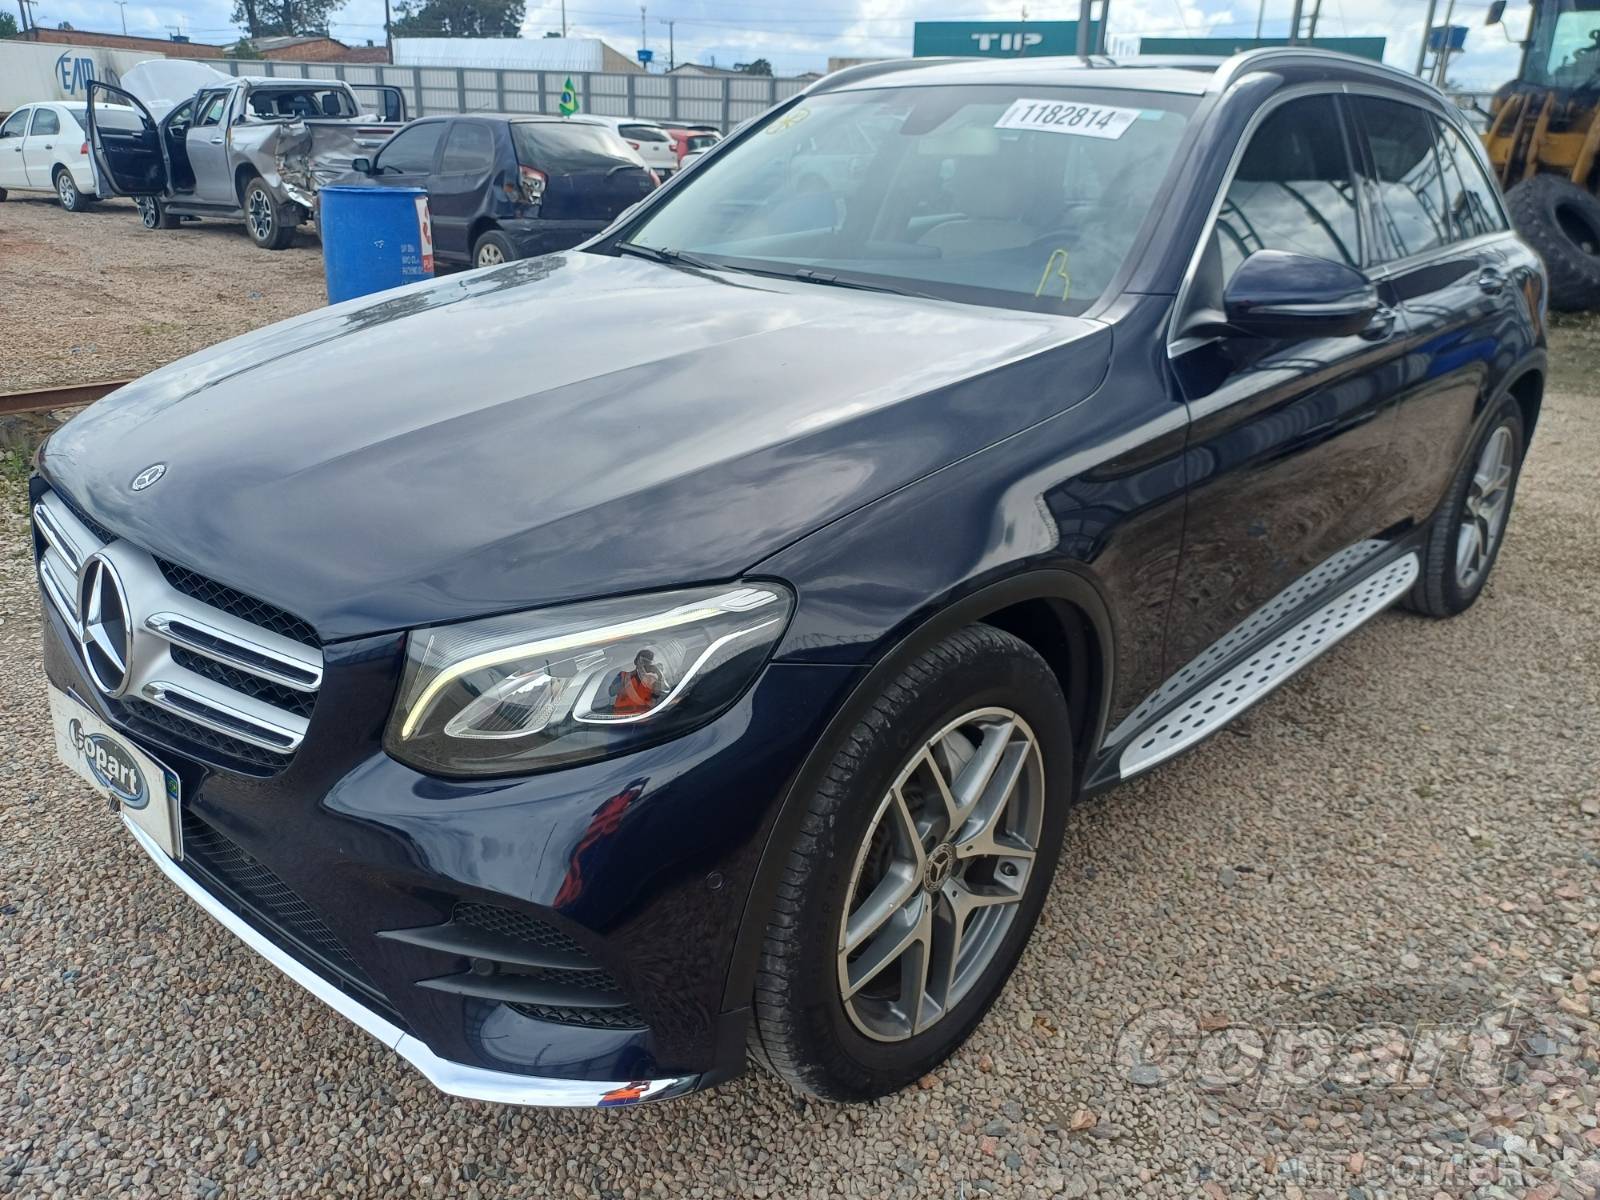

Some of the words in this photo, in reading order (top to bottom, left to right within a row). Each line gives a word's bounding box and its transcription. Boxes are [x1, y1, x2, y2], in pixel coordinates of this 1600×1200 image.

[971, 32, 1043, 51] TIP
[1020, 103, 1116, 130] 1182814
[69, 718, 138, 796] Copart
